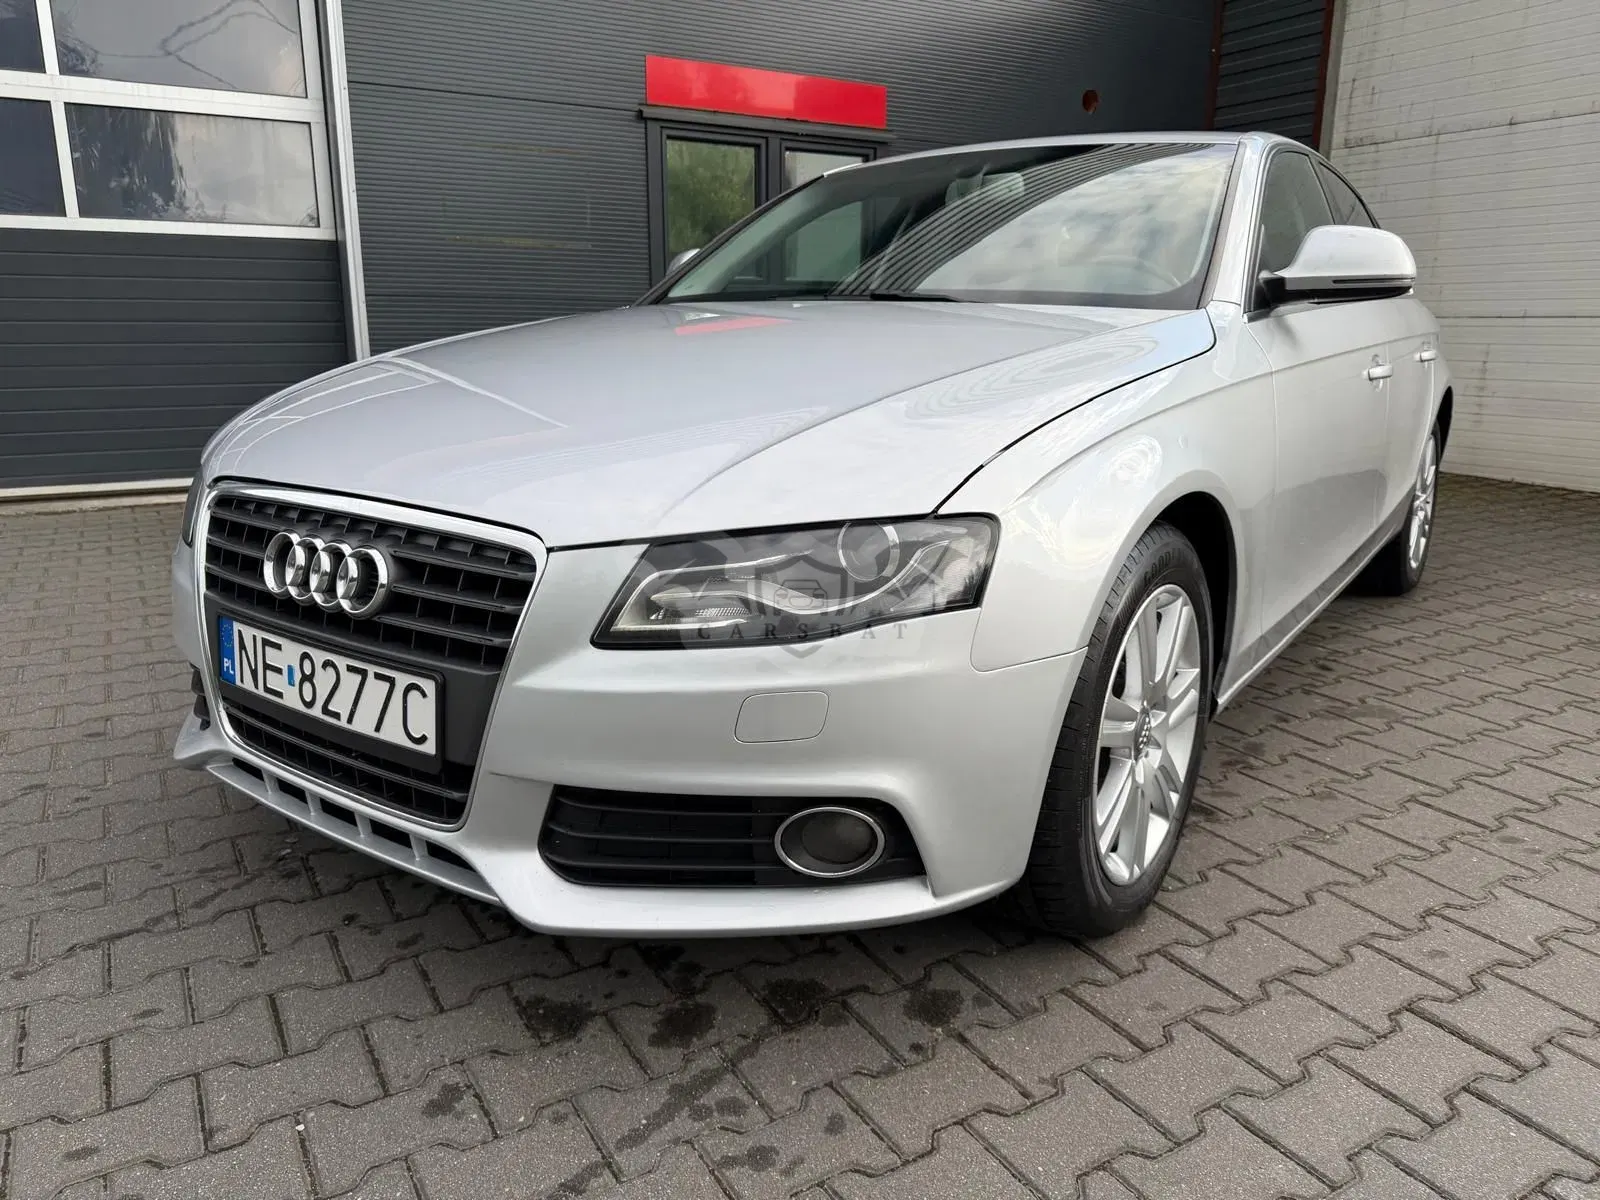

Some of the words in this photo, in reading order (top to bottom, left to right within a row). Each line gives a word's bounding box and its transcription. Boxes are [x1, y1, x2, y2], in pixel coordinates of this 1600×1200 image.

[223, 657, 235, 675] PL
[237, 628, 284, 700] NE
[299, 651, 429, 746] 8277C
